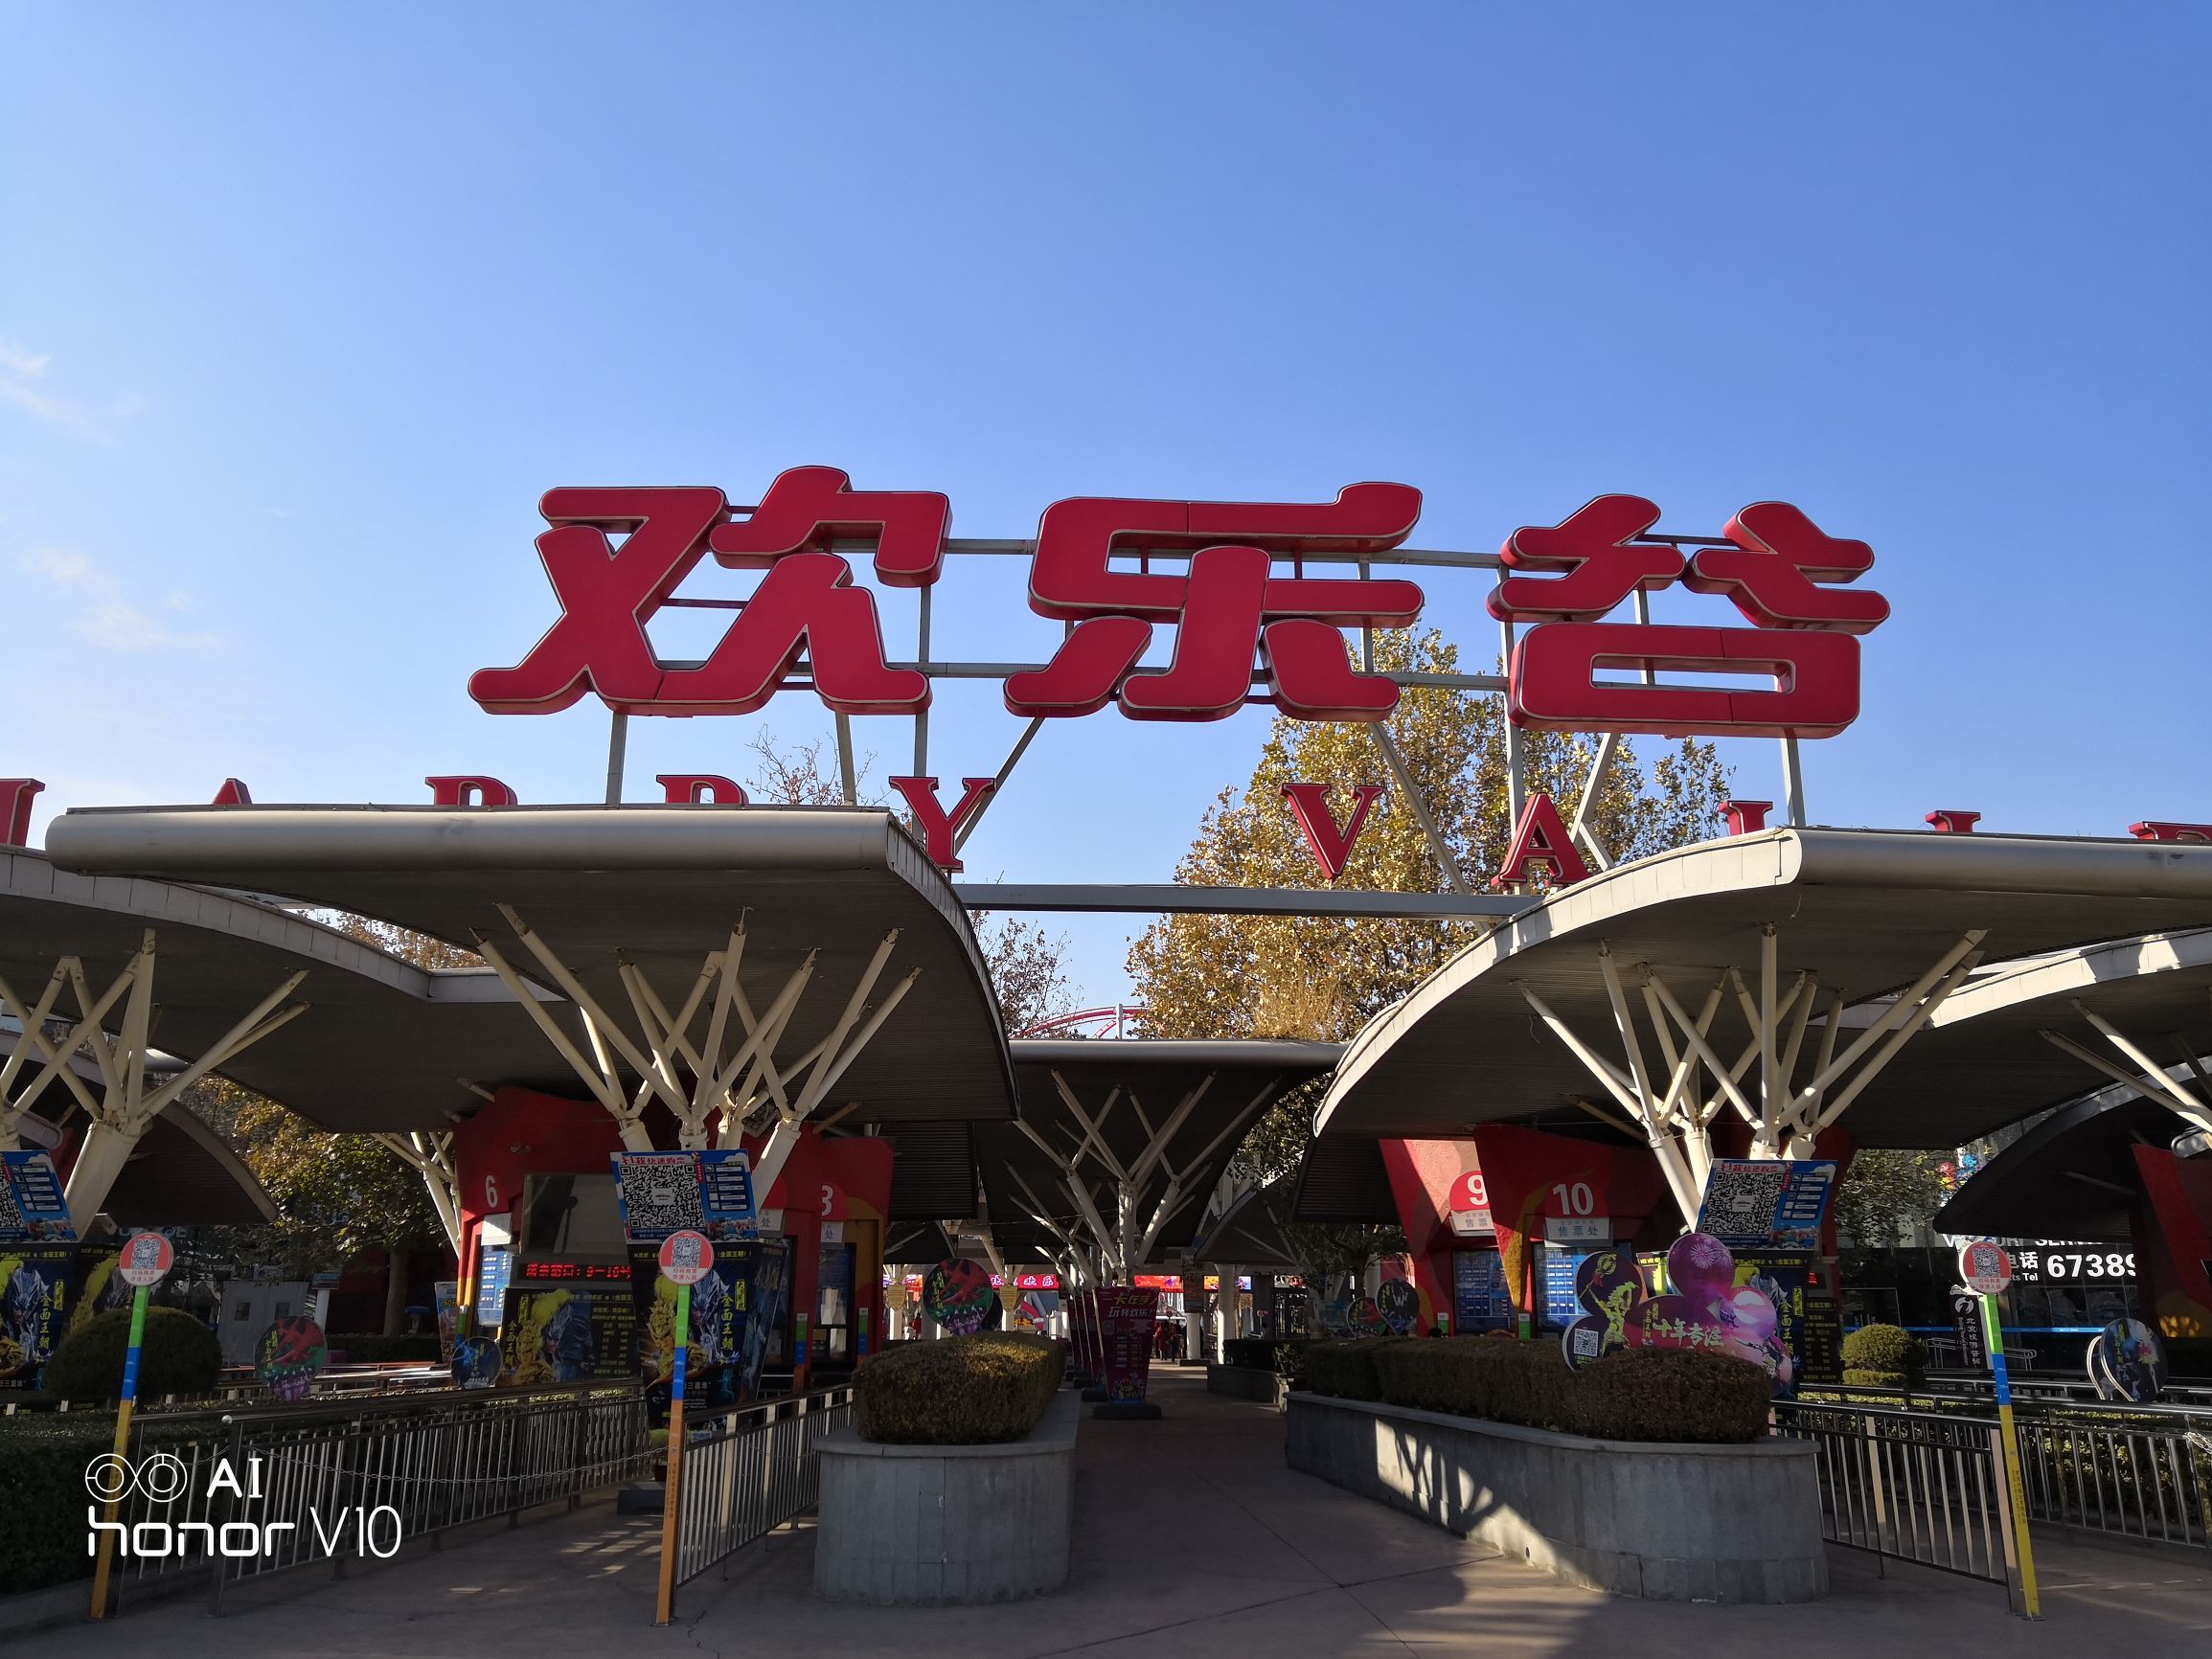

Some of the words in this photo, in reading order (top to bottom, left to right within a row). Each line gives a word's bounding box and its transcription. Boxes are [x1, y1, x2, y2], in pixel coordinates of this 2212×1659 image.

[468, 466, 1890, 738] 欢乐谷
[485, 1174, 498, 1208] 6
[1467, 1174, 1489, 1206] 9
[1552, 1182, 1594, 1216] 10
[1557, 1224, 1599, 1238] 售票处
[2021, 1272, 2039, 1282] Tel
[720, 1294, 735, 1352] 金面王朝
